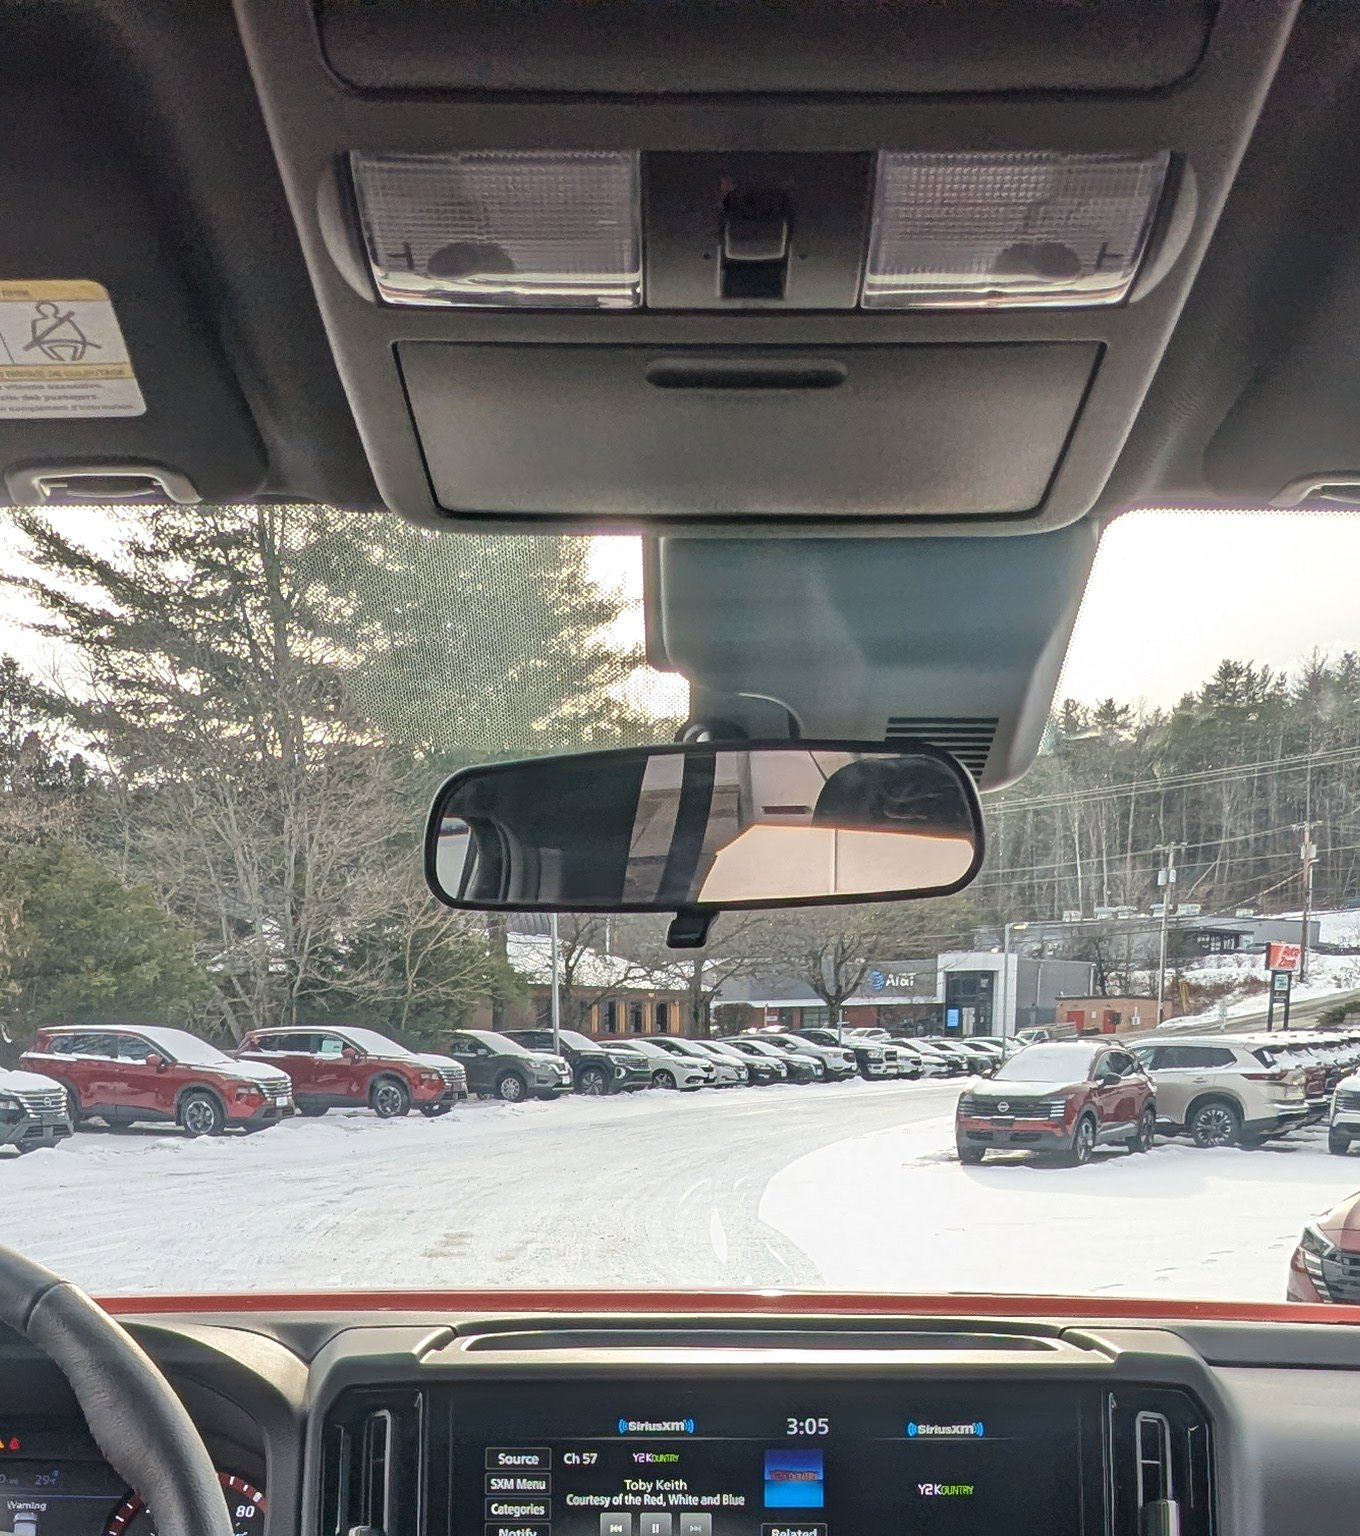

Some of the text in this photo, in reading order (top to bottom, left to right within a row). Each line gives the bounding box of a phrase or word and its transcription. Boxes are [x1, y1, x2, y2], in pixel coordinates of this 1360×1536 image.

[786, 1417, 829, 1435] 3:05
[497, 1453, 539, 1465] Source
[563, 1453, 598, 1465] Ch 57
[490, 1479, 546, 1490] SXM Menu
[624, 1479, 688, 1492] Toby Keith
[7, 1500, 48, 1511] Warning
[566, 1494, 745, 1508] Courtesy of the Red, White and Blue
[235, 1505, 256, 1518] 80
[490, 1503, 545, 1516] Categories
